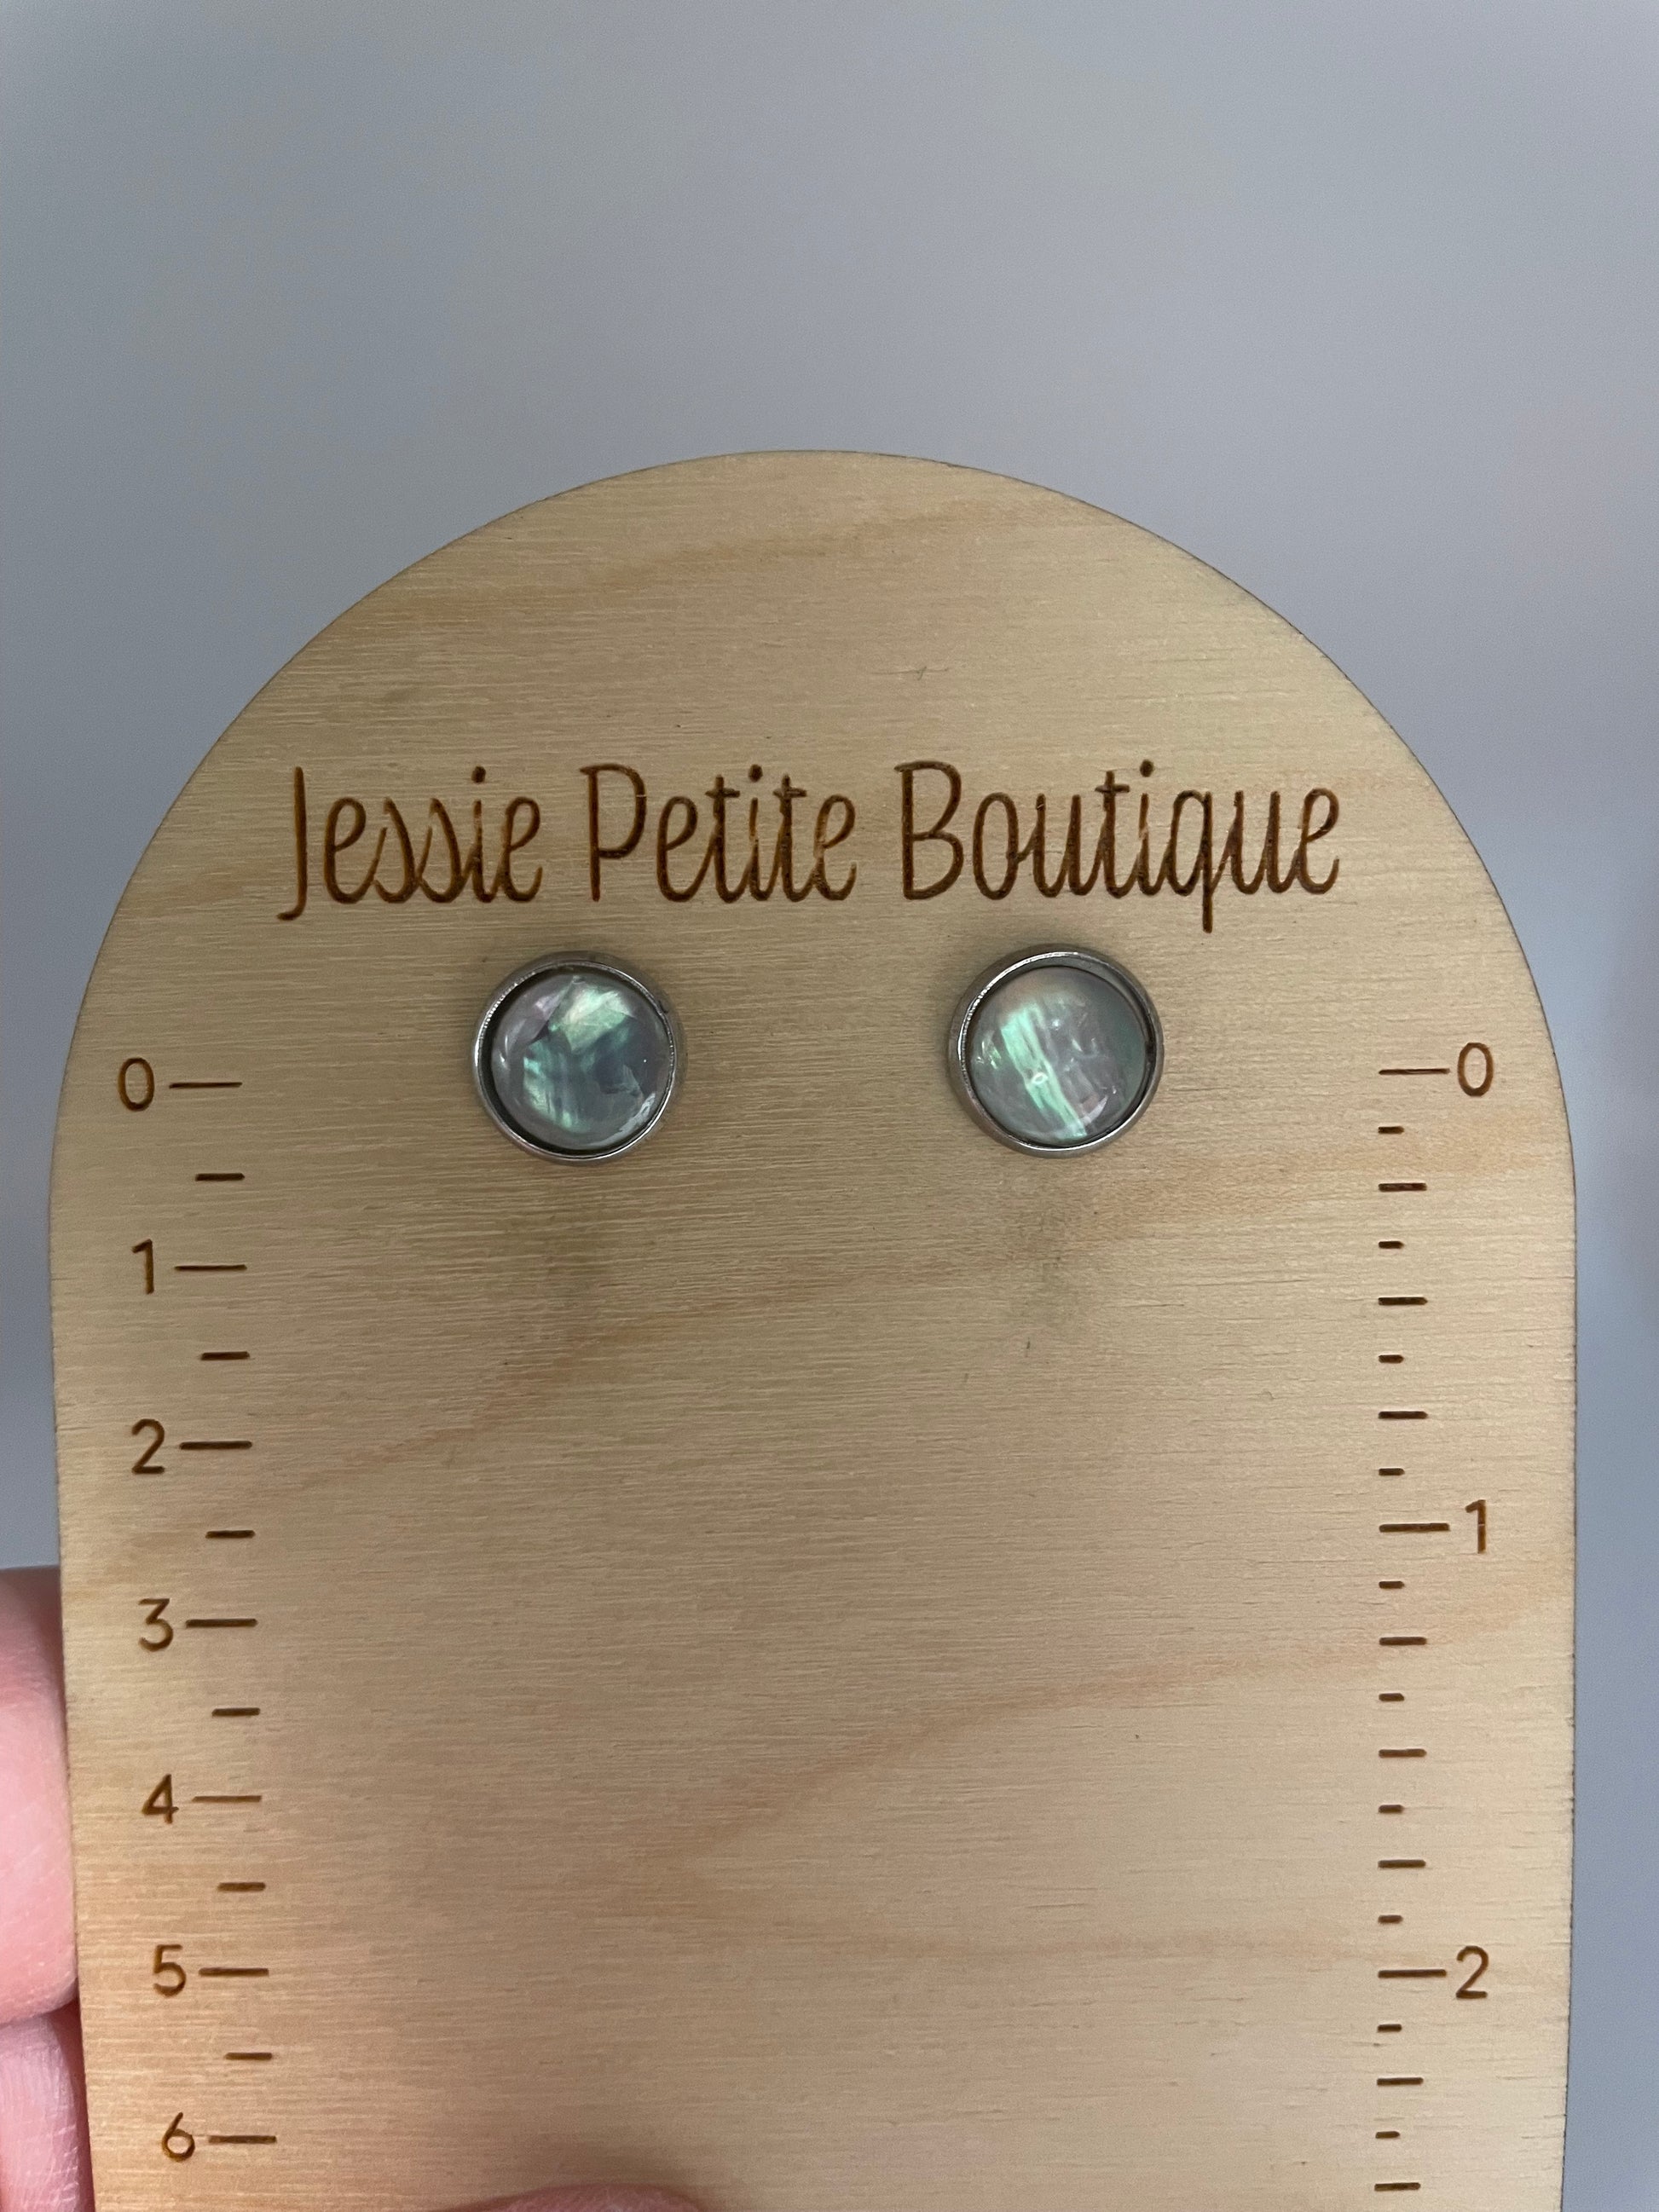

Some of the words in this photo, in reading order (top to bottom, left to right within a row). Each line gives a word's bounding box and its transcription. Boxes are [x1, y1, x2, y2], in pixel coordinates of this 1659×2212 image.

[275, 765, 544, 921] Jessie
[578, 763, 858, 904] Petite
[893, 759, 1341, 934] Boutique
[118, 1056, 155, 1112] 0
[1456, 1042, 1495, 1099] 0
[131, 1239, 155, 1296] 1
[130, 1418, 166, 1476] 2
[1464, 1499, 1488, 1555] 1
[137, 1597, 174, 1654] 3
[141, 1773, 180, 1825] 4
[152, 1943, 188, 1999] 5
[1454, 1945, 1489, 2001] 2
[160, 2111, 196, 2164] 6
